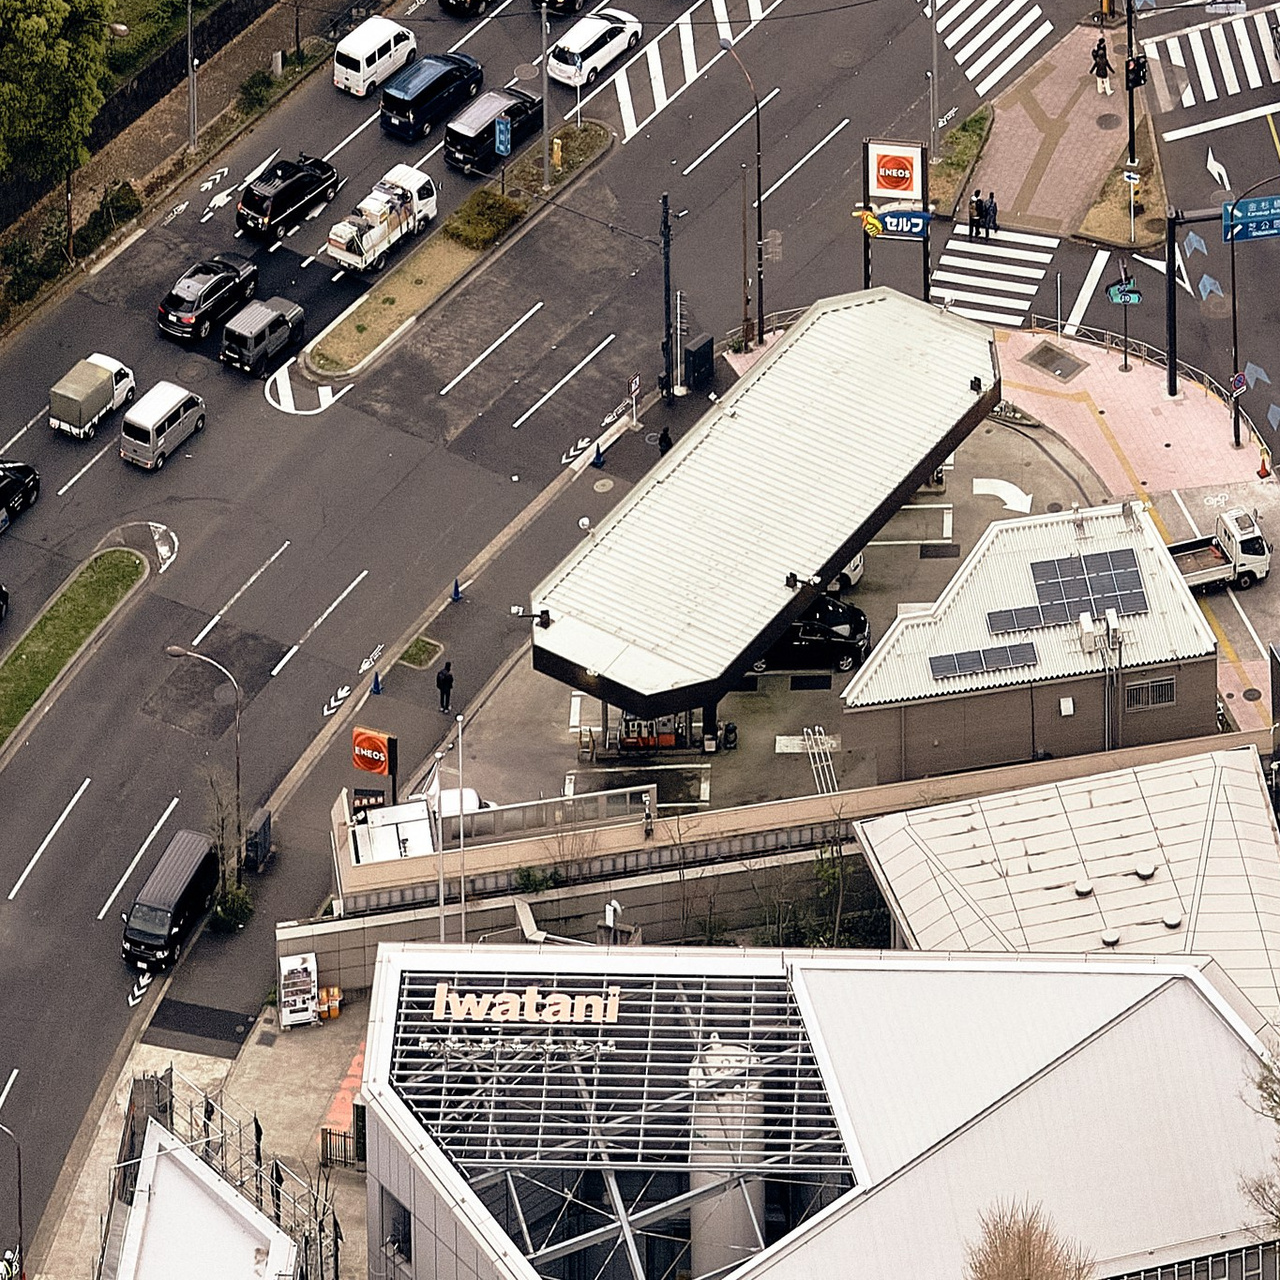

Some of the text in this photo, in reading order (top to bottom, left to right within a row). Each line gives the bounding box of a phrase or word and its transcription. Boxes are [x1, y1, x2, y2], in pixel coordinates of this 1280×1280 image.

[879, 167, 911, 179] ENEOS
[884, 215, 924, 233] セルフ
[354, 746, 386, 762] ENEOS
[432, 982, 621, 1023] Iwatani
